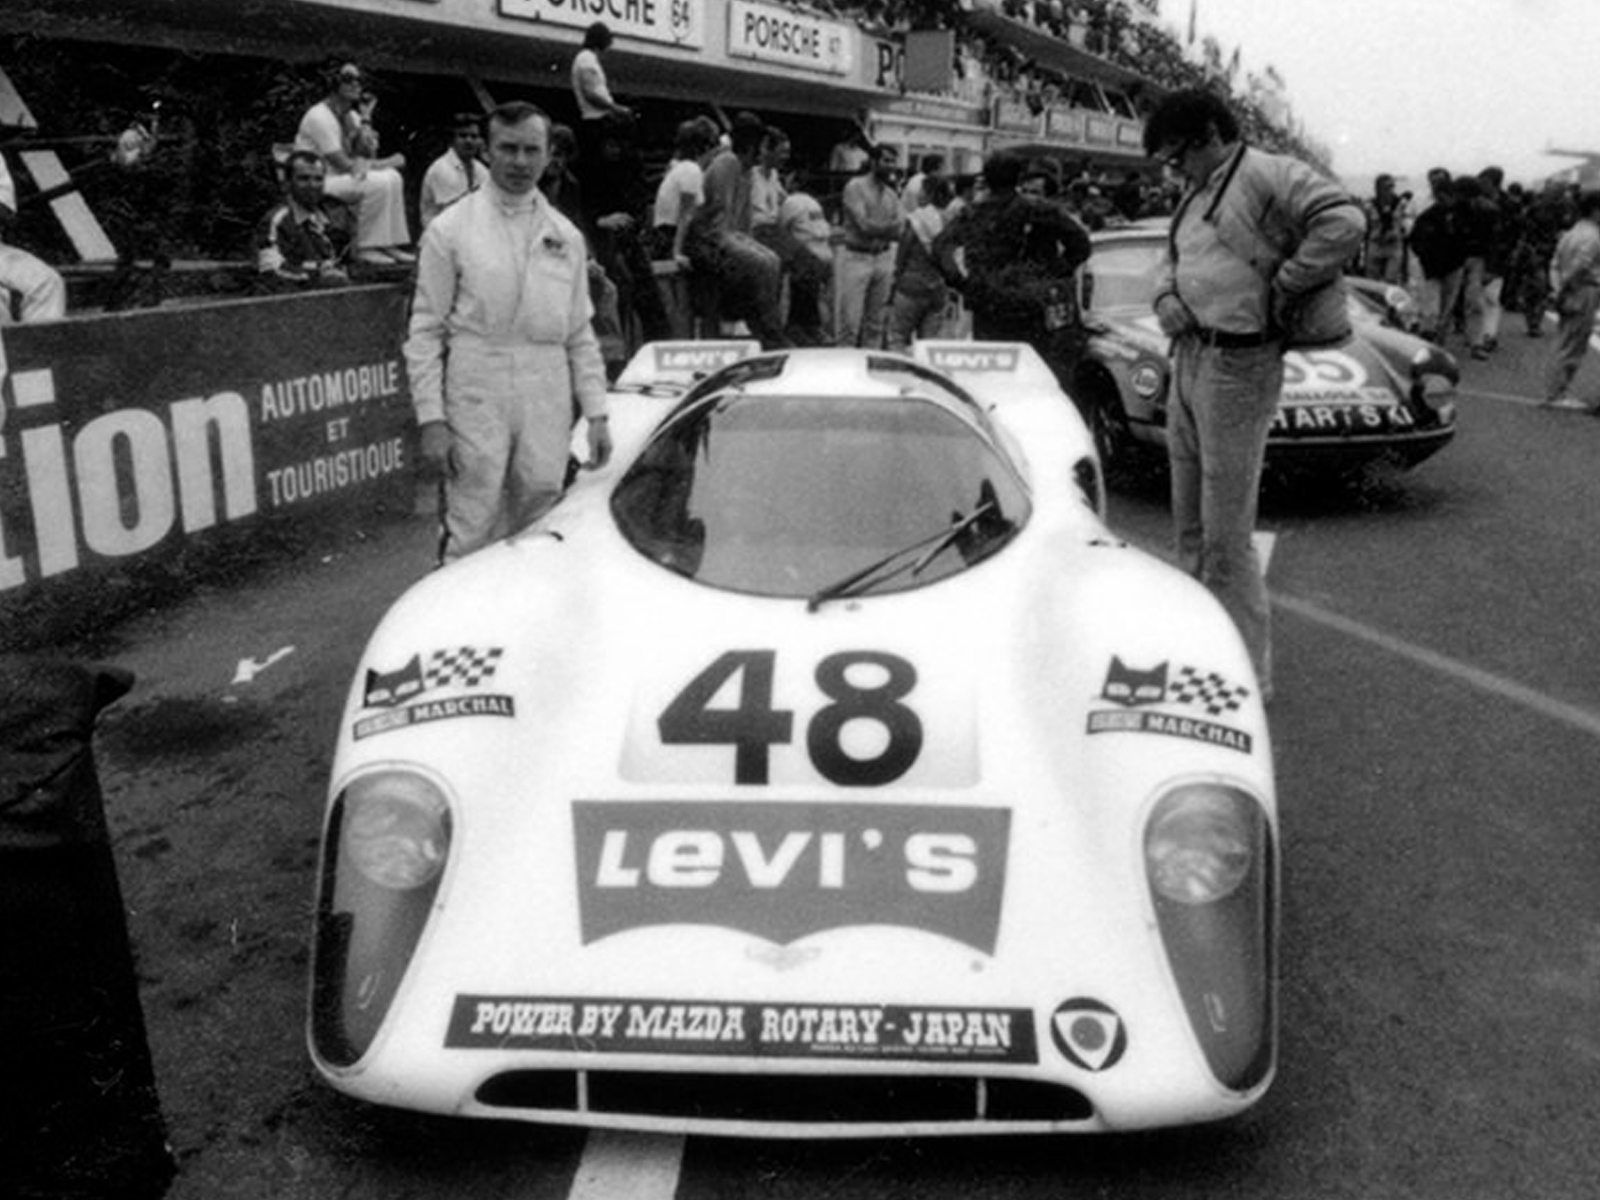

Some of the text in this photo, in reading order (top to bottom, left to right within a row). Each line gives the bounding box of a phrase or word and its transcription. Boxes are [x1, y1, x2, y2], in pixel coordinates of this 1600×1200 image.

[524, 0, 656, 26] SCHE
[744, 11, 820, 59] PORSCHE
[261, 360, 399, 422] AUTOMOBILE
[326, 417, 350, 443] ET
[0, 368, 258, 591] ion
[267, 437, 405, 507] TOURISTIQUE
[413, 697, 510, 722] MARCHAL
[657, 649, 924, 788] 48
[1147, 714, 1247, 750] MARCHAL
[469, 1002, 575, 1035] POWER
[577, 1004, 623, 1038] BY
[625, 1004, 746, 1041] MAZDA
[902, 1011, 1012, 1048] JAPAN
